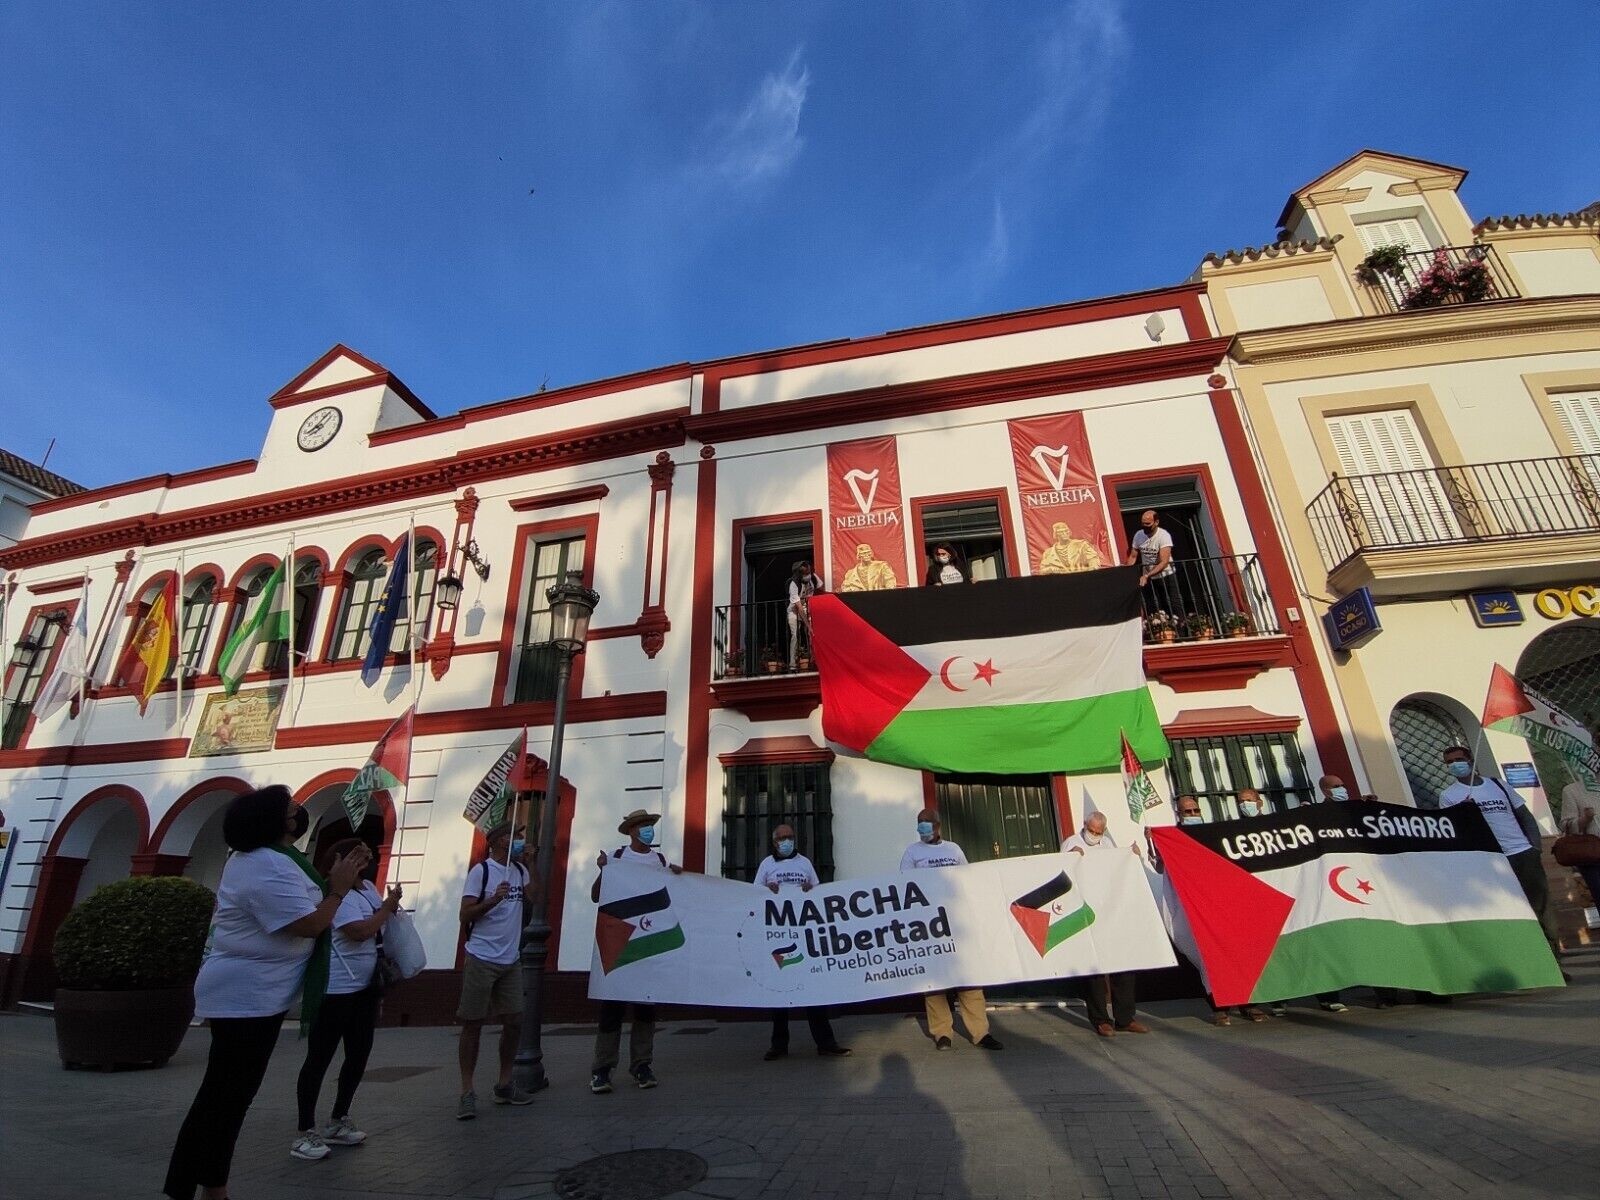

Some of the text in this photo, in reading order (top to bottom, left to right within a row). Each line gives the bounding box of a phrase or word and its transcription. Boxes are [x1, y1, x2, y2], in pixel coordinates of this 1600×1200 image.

[1027, 488, 1095, 506] NEBRIJA
[836, 511, 899, 528] NEBRIJA
[1535, 585, 1600, 619] OC
[1340, 616, 1367, 637] OCASO
[1477, 799, 1505, 807] ARCHA
[1362, 809, 1456, 839] SÁHARA
[765, 881, 930, 927] MARCHA
[766, 906, 952, 958] por la libertad
[810, 939, 956, 974] del Pueblo Saharaui
[864, 963, 926, 983] Andalucía
